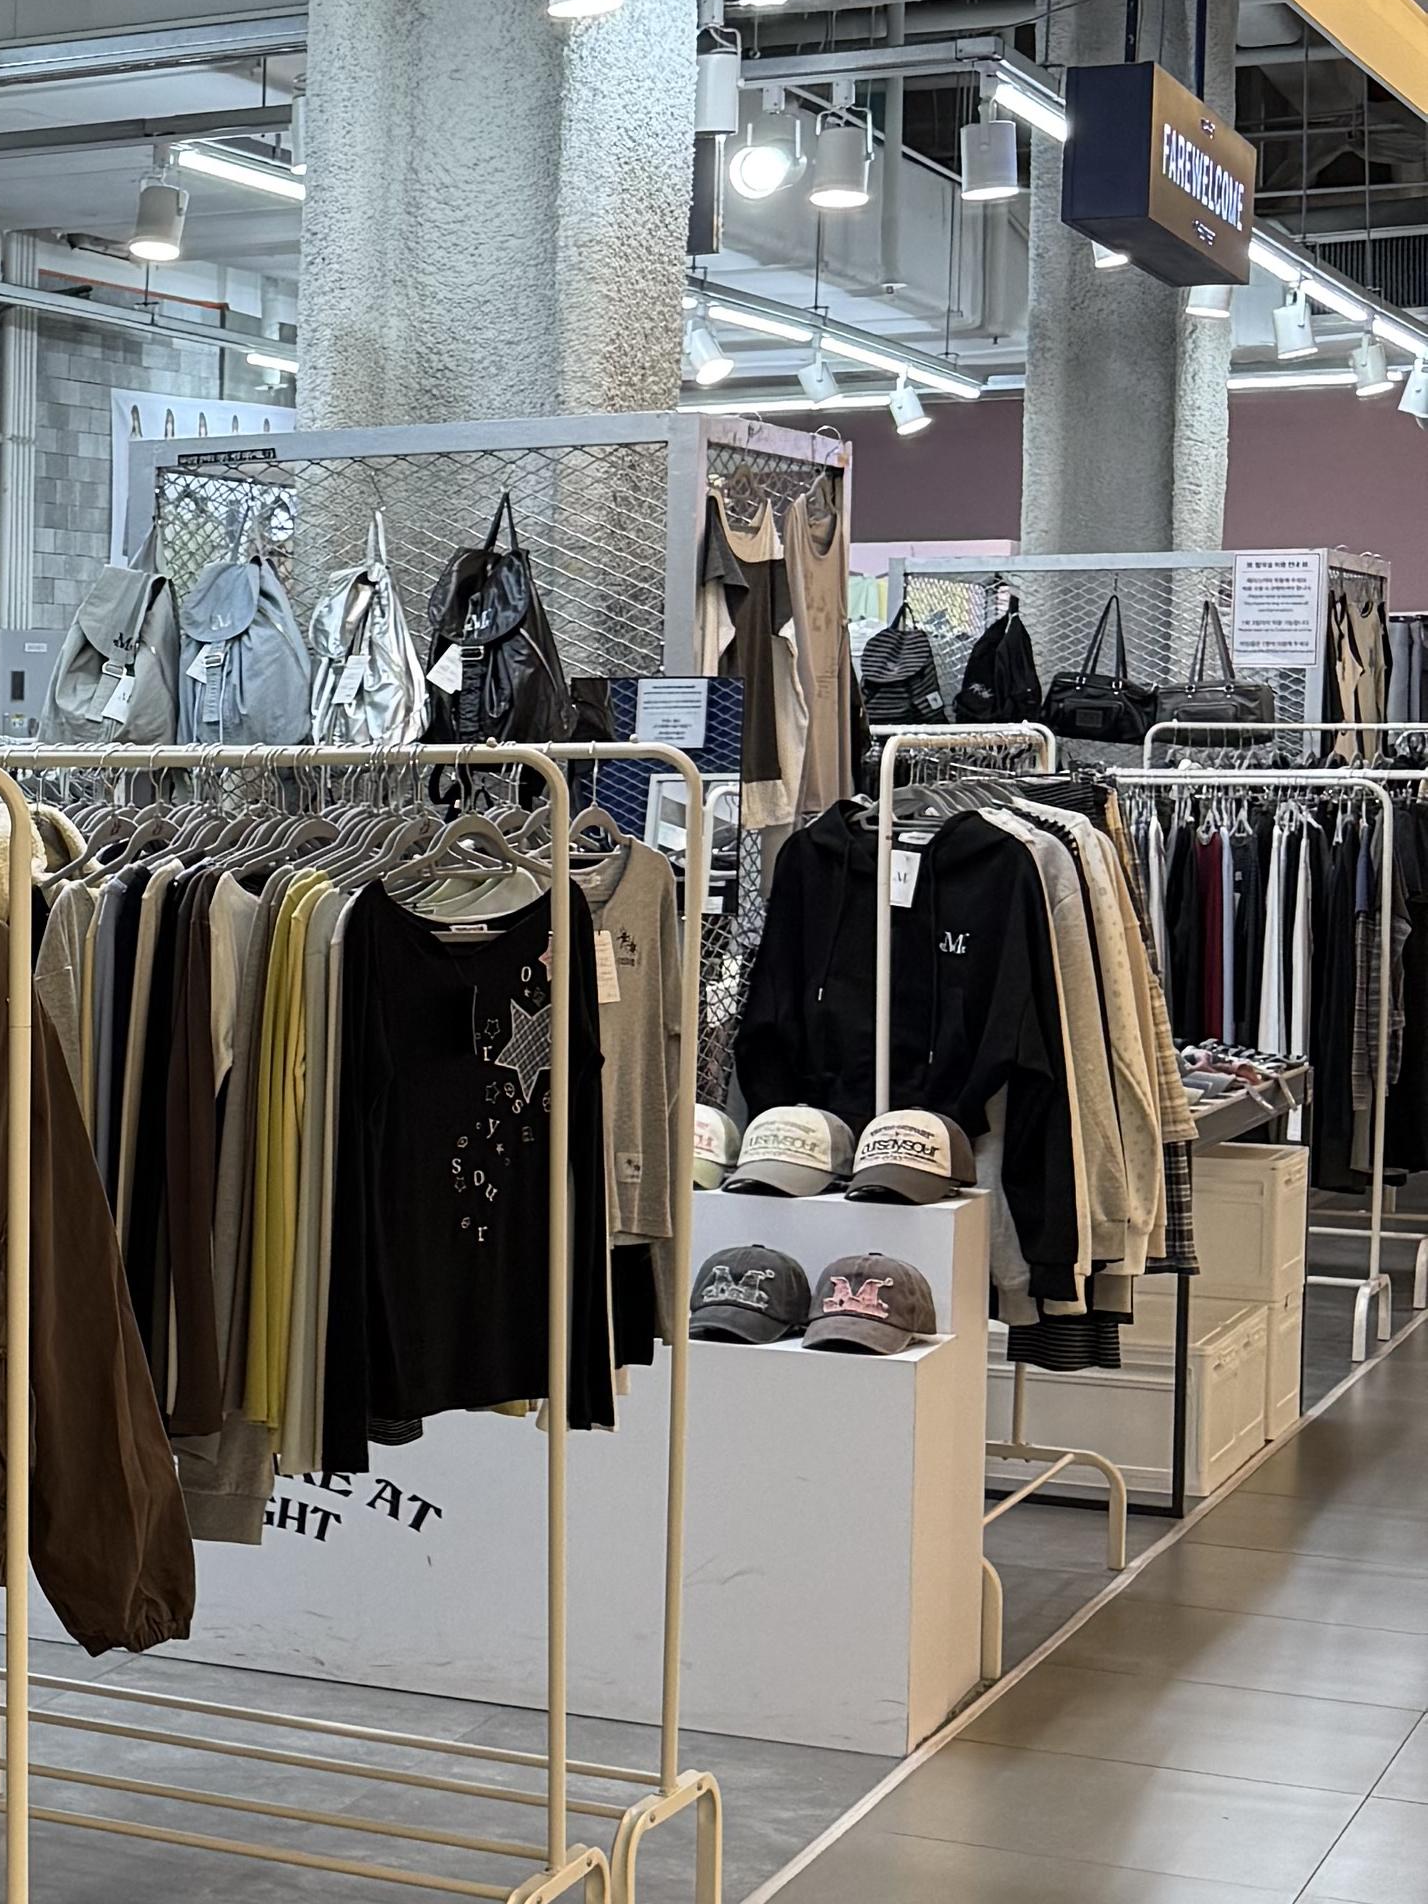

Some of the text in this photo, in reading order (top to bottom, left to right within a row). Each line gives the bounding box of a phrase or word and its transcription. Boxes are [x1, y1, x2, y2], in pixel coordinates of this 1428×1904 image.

[1162, 123, 1244, 232] FAREWELCOME
[263, 1496, 343, 1543] GHT
[365, 1478, 443, 1533] AT
